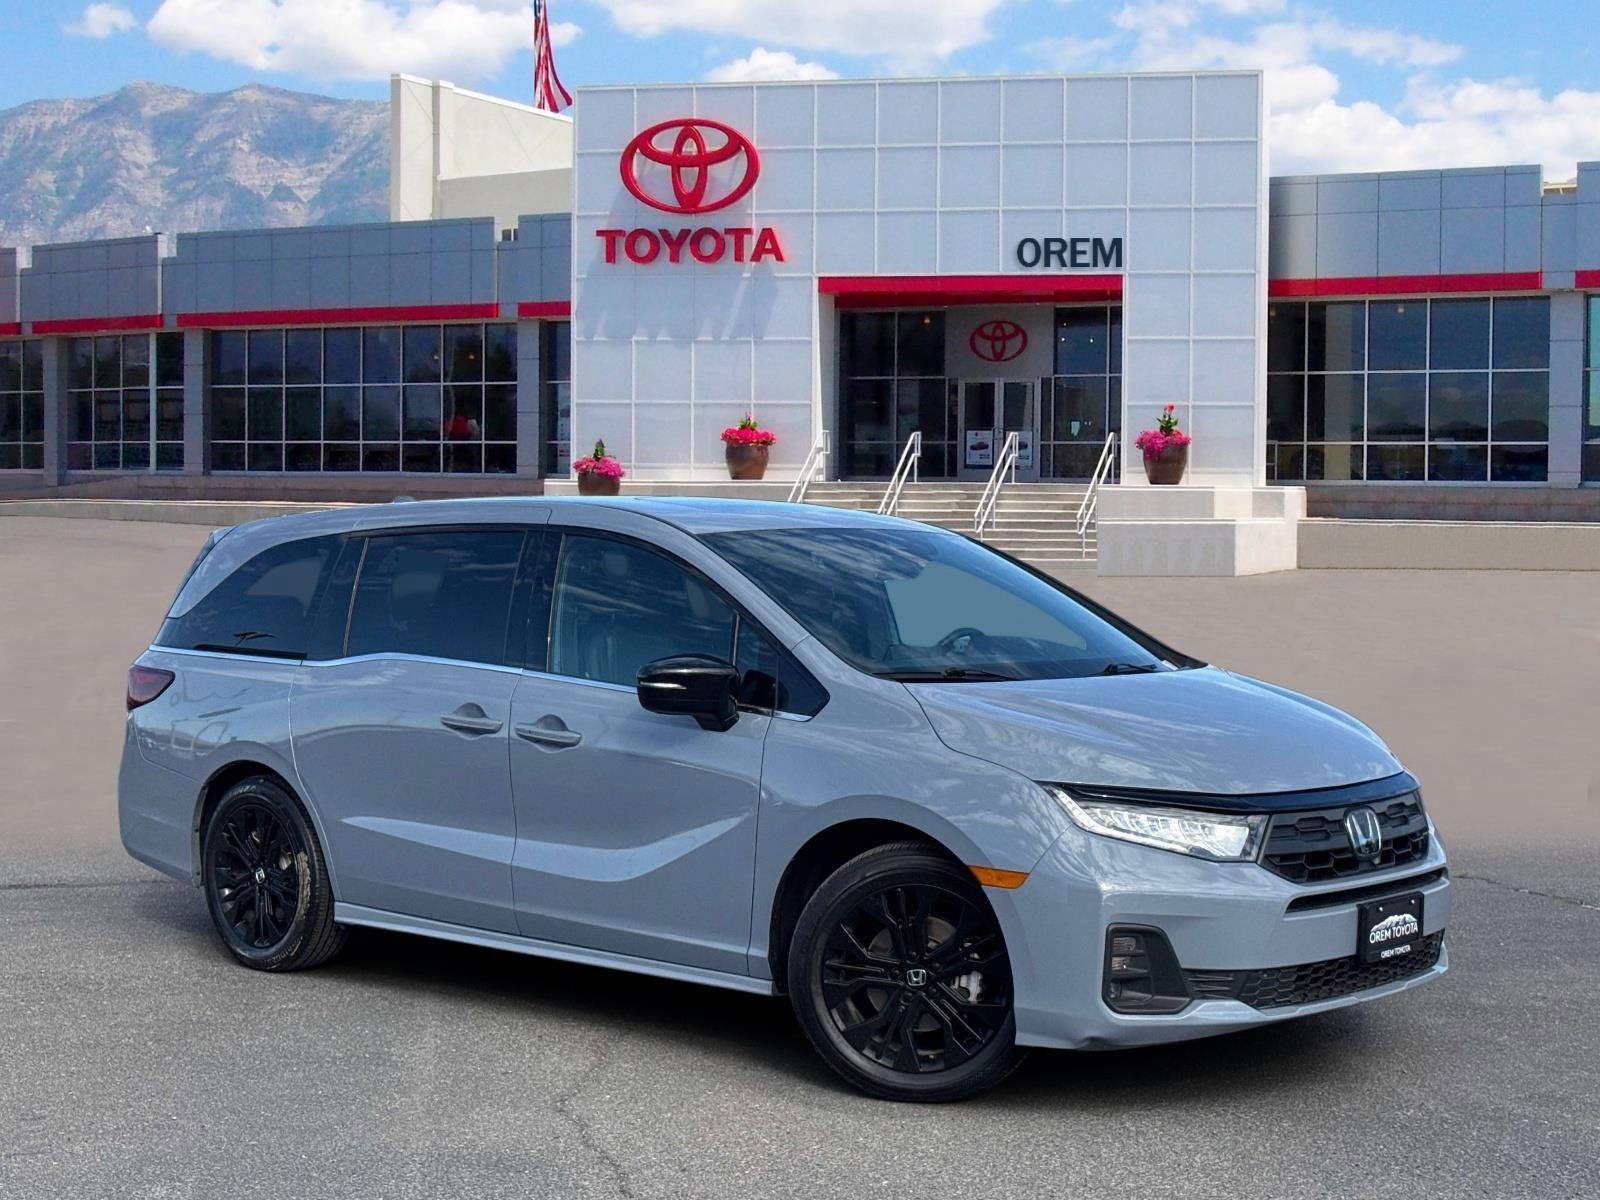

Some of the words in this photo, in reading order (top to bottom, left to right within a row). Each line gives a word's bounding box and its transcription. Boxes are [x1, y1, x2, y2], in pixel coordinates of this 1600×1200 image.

[595, 227, 785, 264] TOYOTA
[1016, 237, 1123, 268] OREM
[1369, 928, 1391, 944] OREM
[1392, 922, 1418, 938] TOYOTA
[1381, 949, 1394, 959] OREM
